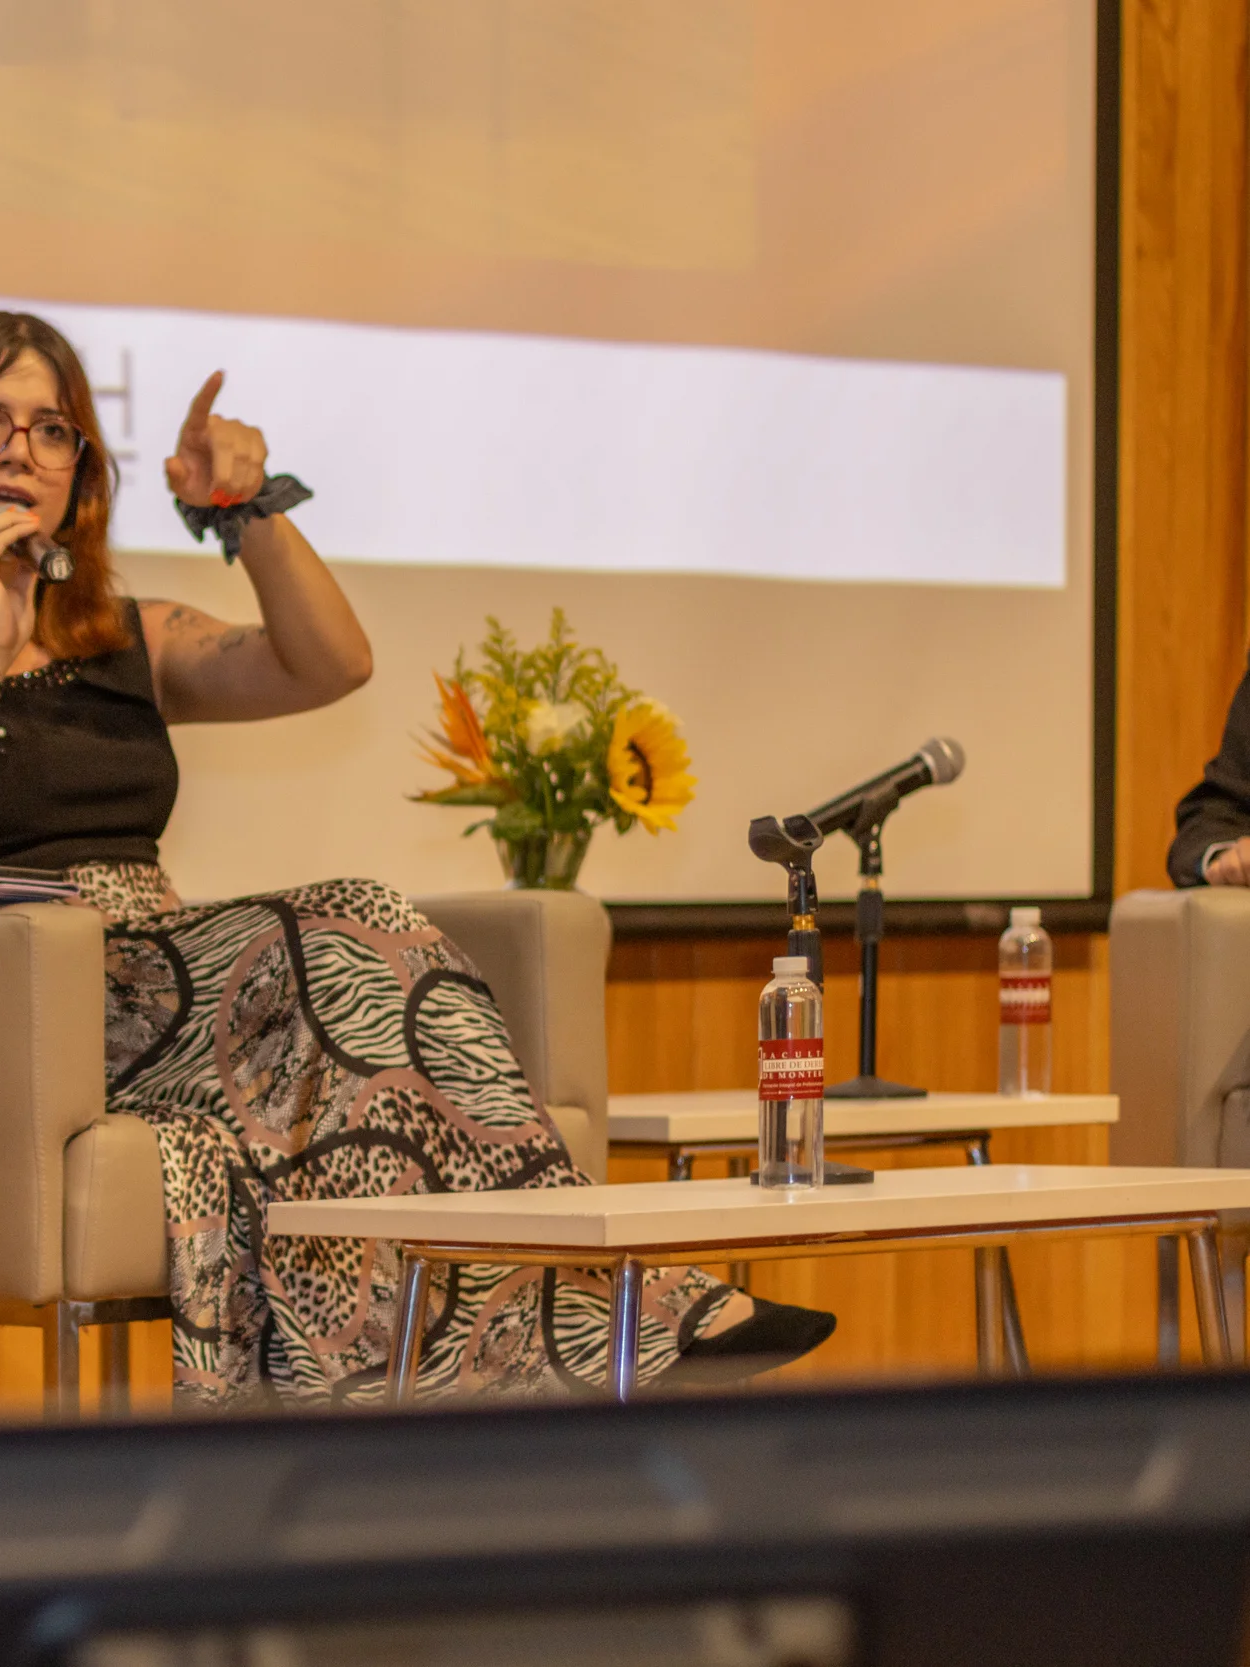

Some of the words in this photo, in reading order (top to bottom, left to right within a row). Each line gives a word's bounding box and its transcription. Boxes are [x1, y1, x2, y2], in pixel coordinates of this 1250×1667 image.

[764, 1061, 786, 1070] LIBRE
[790, 1060, 802, 1069] DE
[762, 1071, 773, 1080] DE
